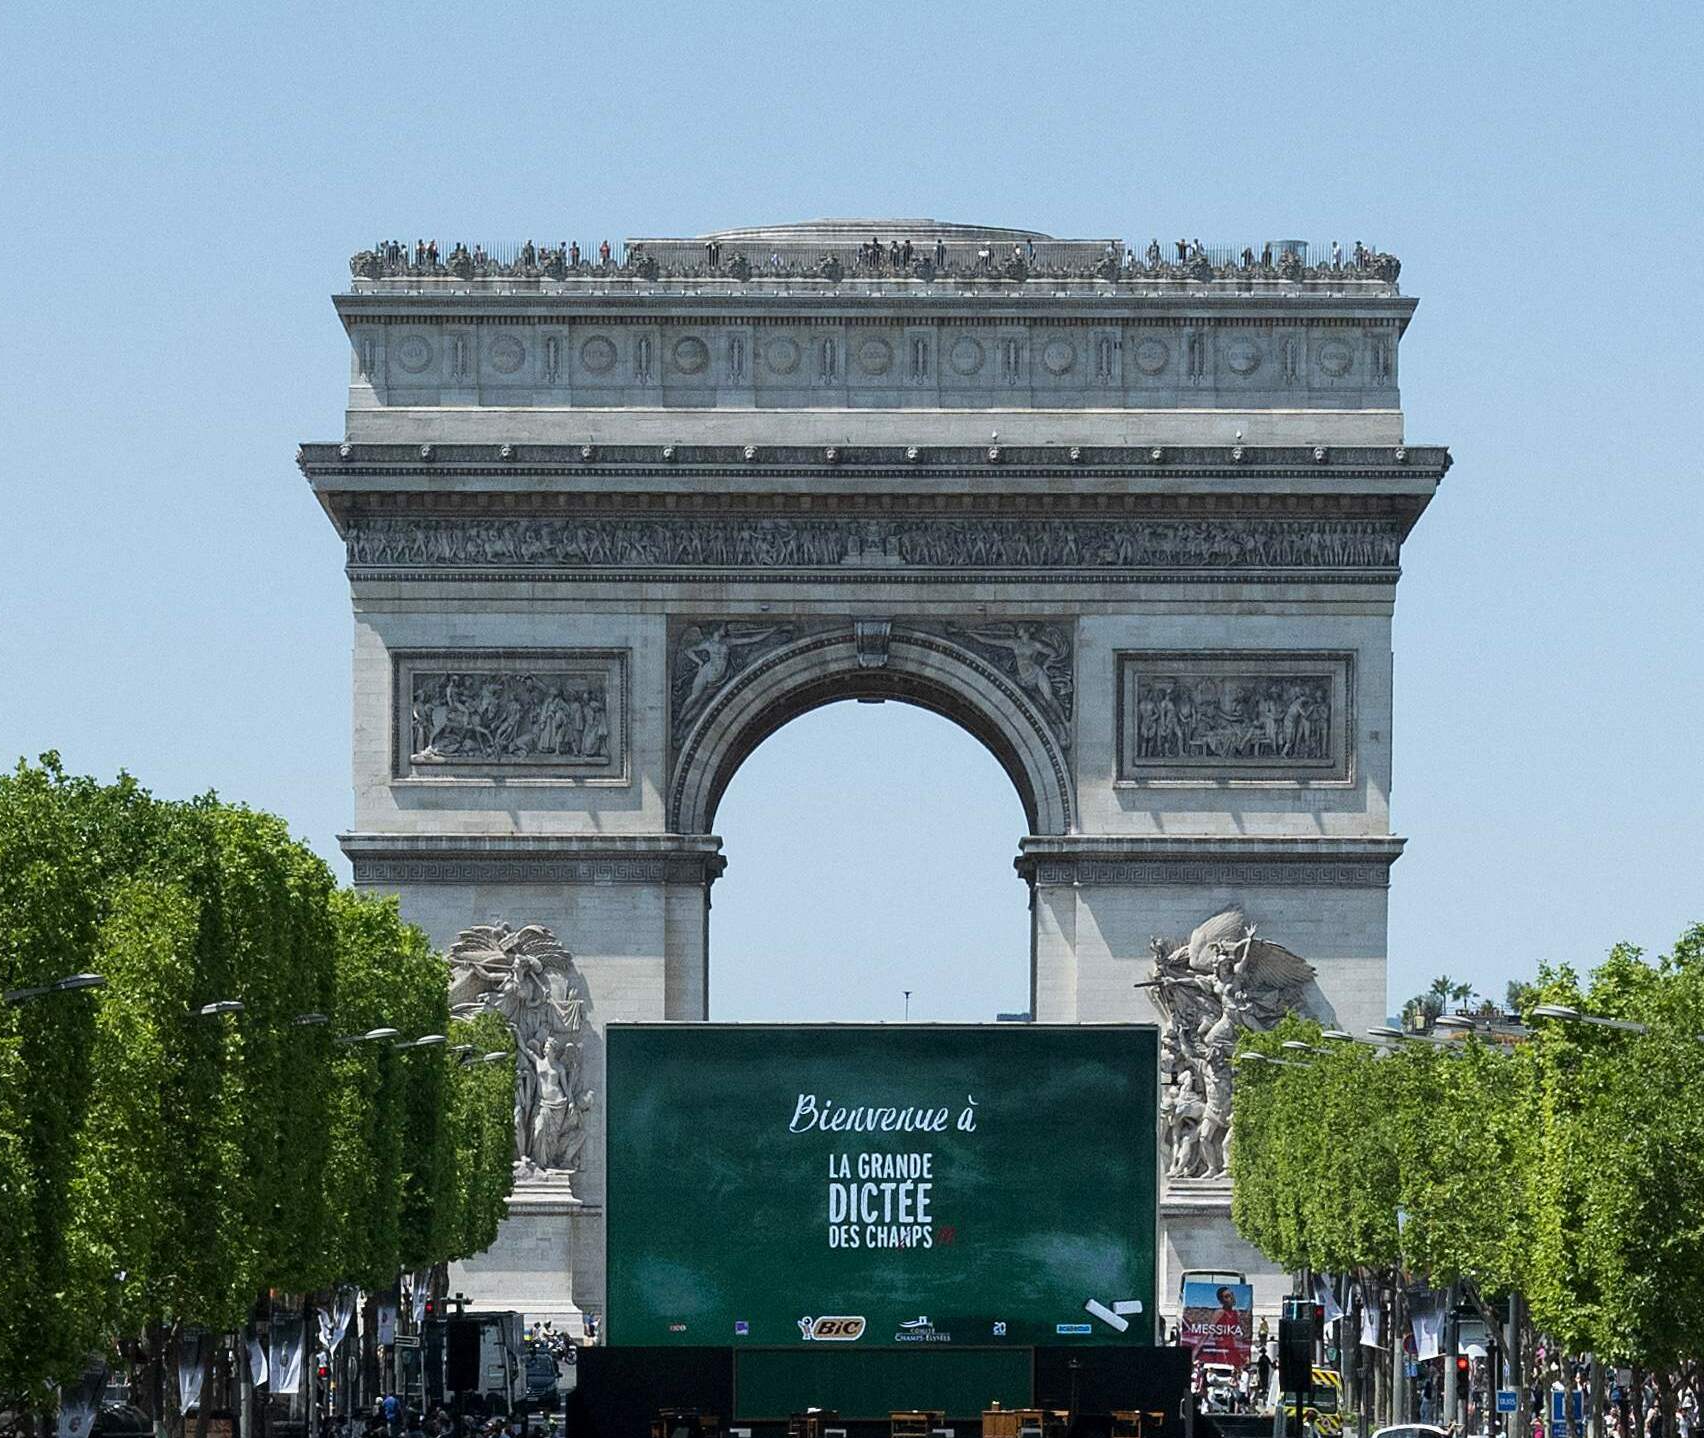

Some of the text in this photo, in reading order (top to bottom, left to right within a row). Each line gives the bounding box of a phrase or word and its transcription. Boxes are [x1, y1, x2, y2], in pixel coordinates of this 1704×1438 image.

[789, 1094, 979, 1133] Bienvenue à
[829, 1153, 933, 1179] LA GRANDE
[829, 1179, 933, 1224] DICTÉE
[829, 1226, 860, 1249] DES
[1192, 1322, 1243, 1337] MESSIKA
